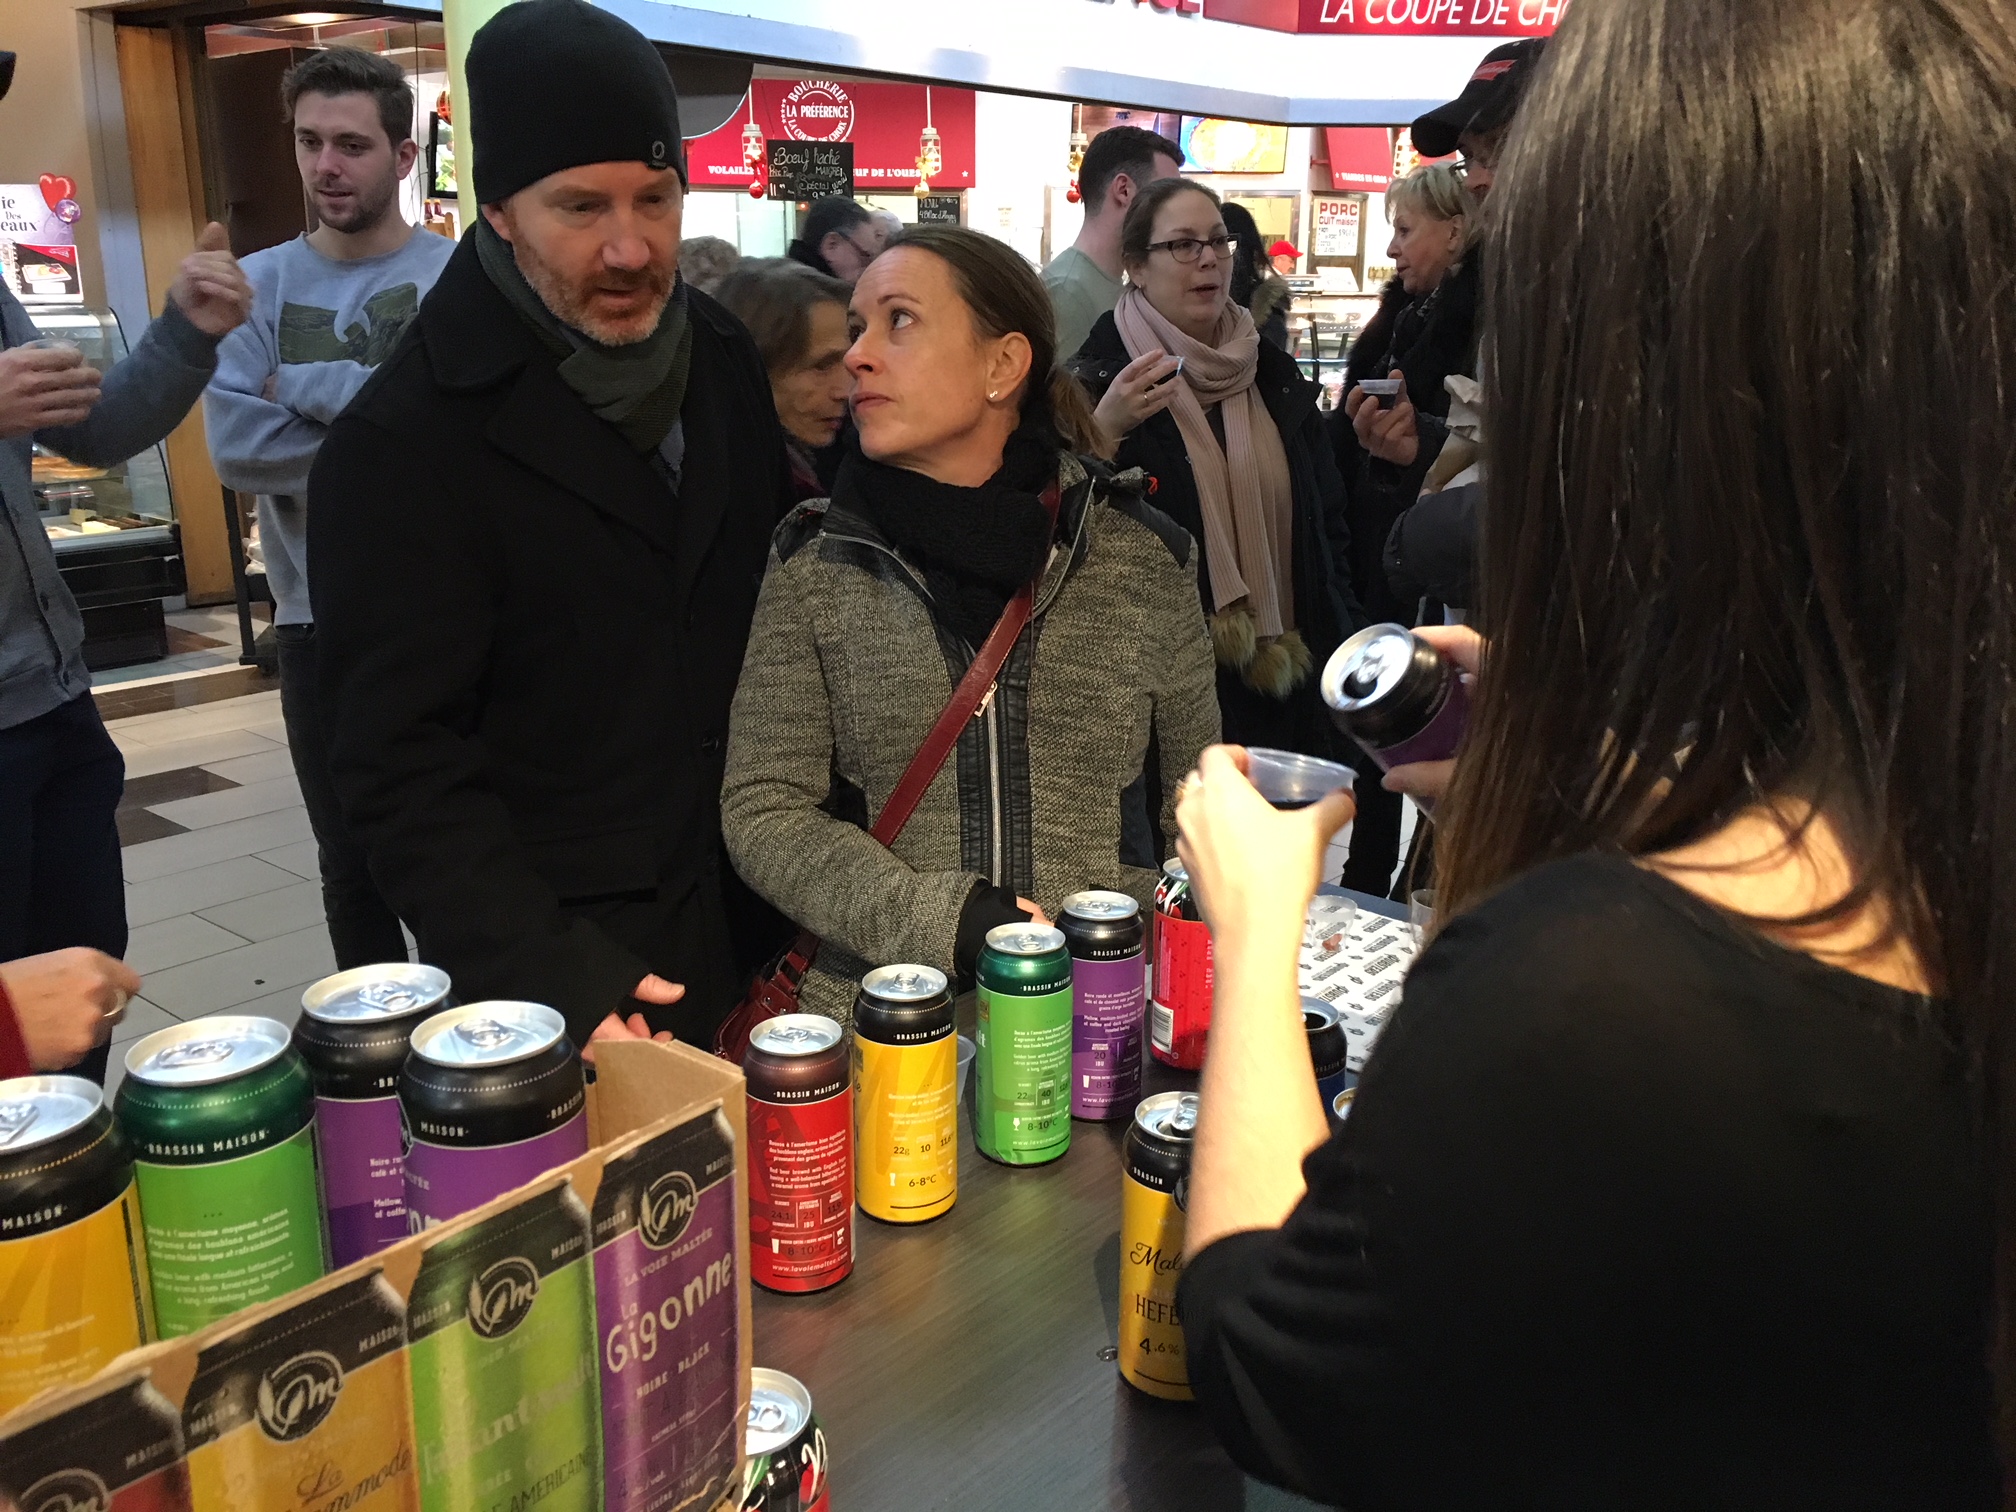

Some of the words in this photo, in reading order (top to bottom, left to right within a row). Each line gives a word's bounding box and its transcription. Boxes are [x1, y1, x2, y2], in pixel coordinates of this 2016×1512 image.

[1319, 0, 1354, 25] LA
[1362, 0, 1459, 26] COUPE
[1466, 0, 1510, 27] DE
[788, 79, 849, 104] BOUCHERIE
[786, 104, 798, 118] LA
[800, 102, 849, 119] PRÉFÉRENCE
[787, 119, 798, 131] LA
[828, 120, 848, 142] CHOIX
[813, 147, 841, 166] haché
[873, 167, 886, 178] DE
[888, 167, 922, 178] L'OUES
[1319, 202, 1358, 217] PORC
[1318, 216, 1336, 226] CUIT
[1336, 217, 1358, 227] maison
[1092, 948, 1121, 957] BRASSIN
[1022, 983, 1052, 993] BRASSIN
[895, 1031, 928, 1041] BRASSIN
[930, 1023, 952, 1037] MAISON
[1094, 1051, 1106, 1060] 20
[776, 1090, 810, 1100] BRASSIN
[813, 1081, 841, 1097] MAISON
[1041, 1089, 1052, 1098] 40
[420, 1121, 466, 1139] MAISON
[146, 1141, 205, 1157] BRASSIN
[213, 1128, 267, 1153] MAISON
[919, 1144, 931, 1155] 10
[370, 1157, 391, 1168] Noire
[371, 1169, 388, 1179] café
[908, 1173, 938, 1188] 6-8°C
[1133, 1166, 1163, 1186] BRASSIN
[374, 1197, 403, 1209] Mellow,
[2, 1203, 64, 1232] MAISON
[803, 1210, 815, 1221] 25
[803, 1220, 815, 1229] IBU
[623, 1270, 641, 1289] LA
[640, 1256, 670, 1279] VOIE
[670, 1225, 714, 1263] MALTÉE
[787, 1242, 826, 1257] 8-10°C
[606, 1252, 735, 1375] Gigonne
[620, 1301, 640, 1322] La
[635, 1370, 670, 1402] NOIRE
[677, 1340, 711, 1376] BLACK
